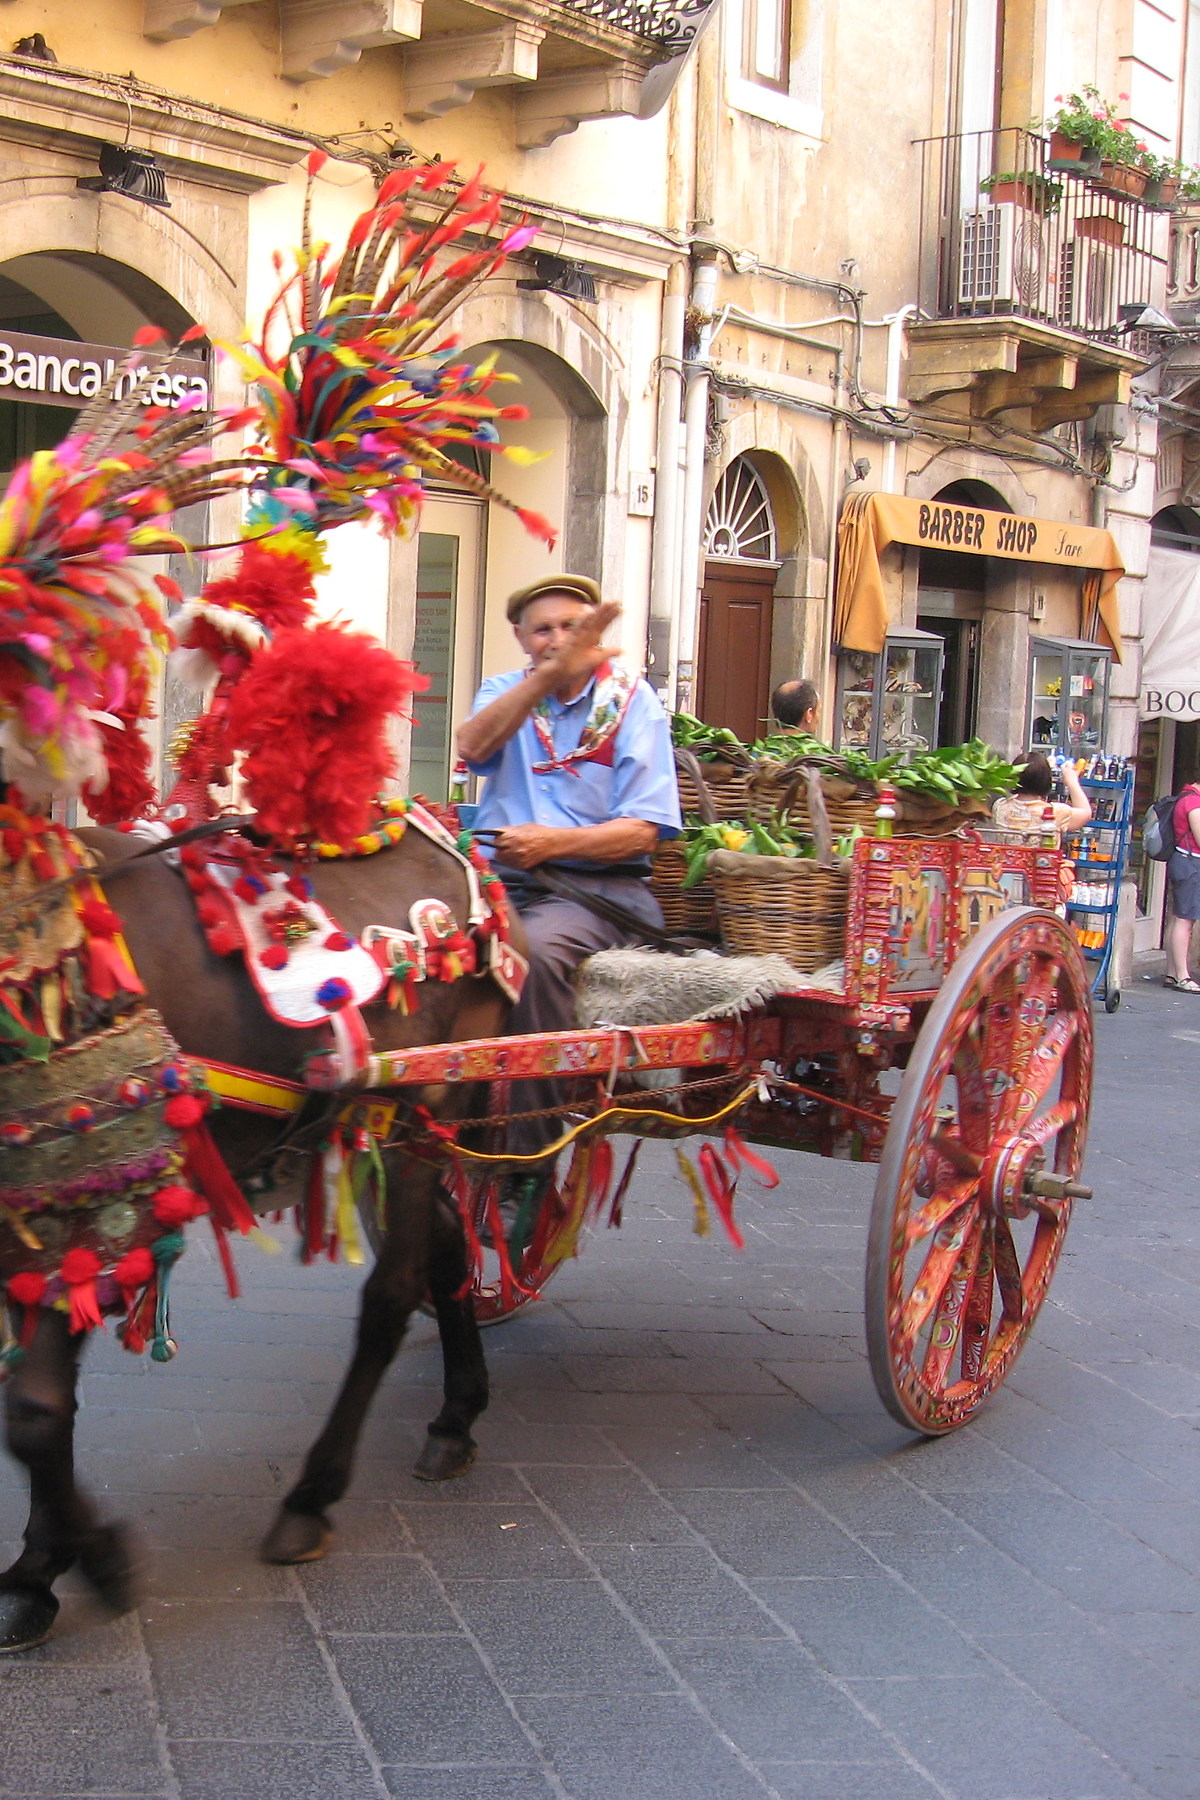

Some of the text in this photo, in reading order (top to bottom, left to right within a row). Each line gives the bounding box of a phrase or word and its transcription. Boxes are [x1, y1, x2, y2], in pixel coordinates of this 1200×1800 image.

[637, 484, 649, 504] 15
[918, 504, 985, 550] BARBER
[997, 517, 1038, 554] SHOP
